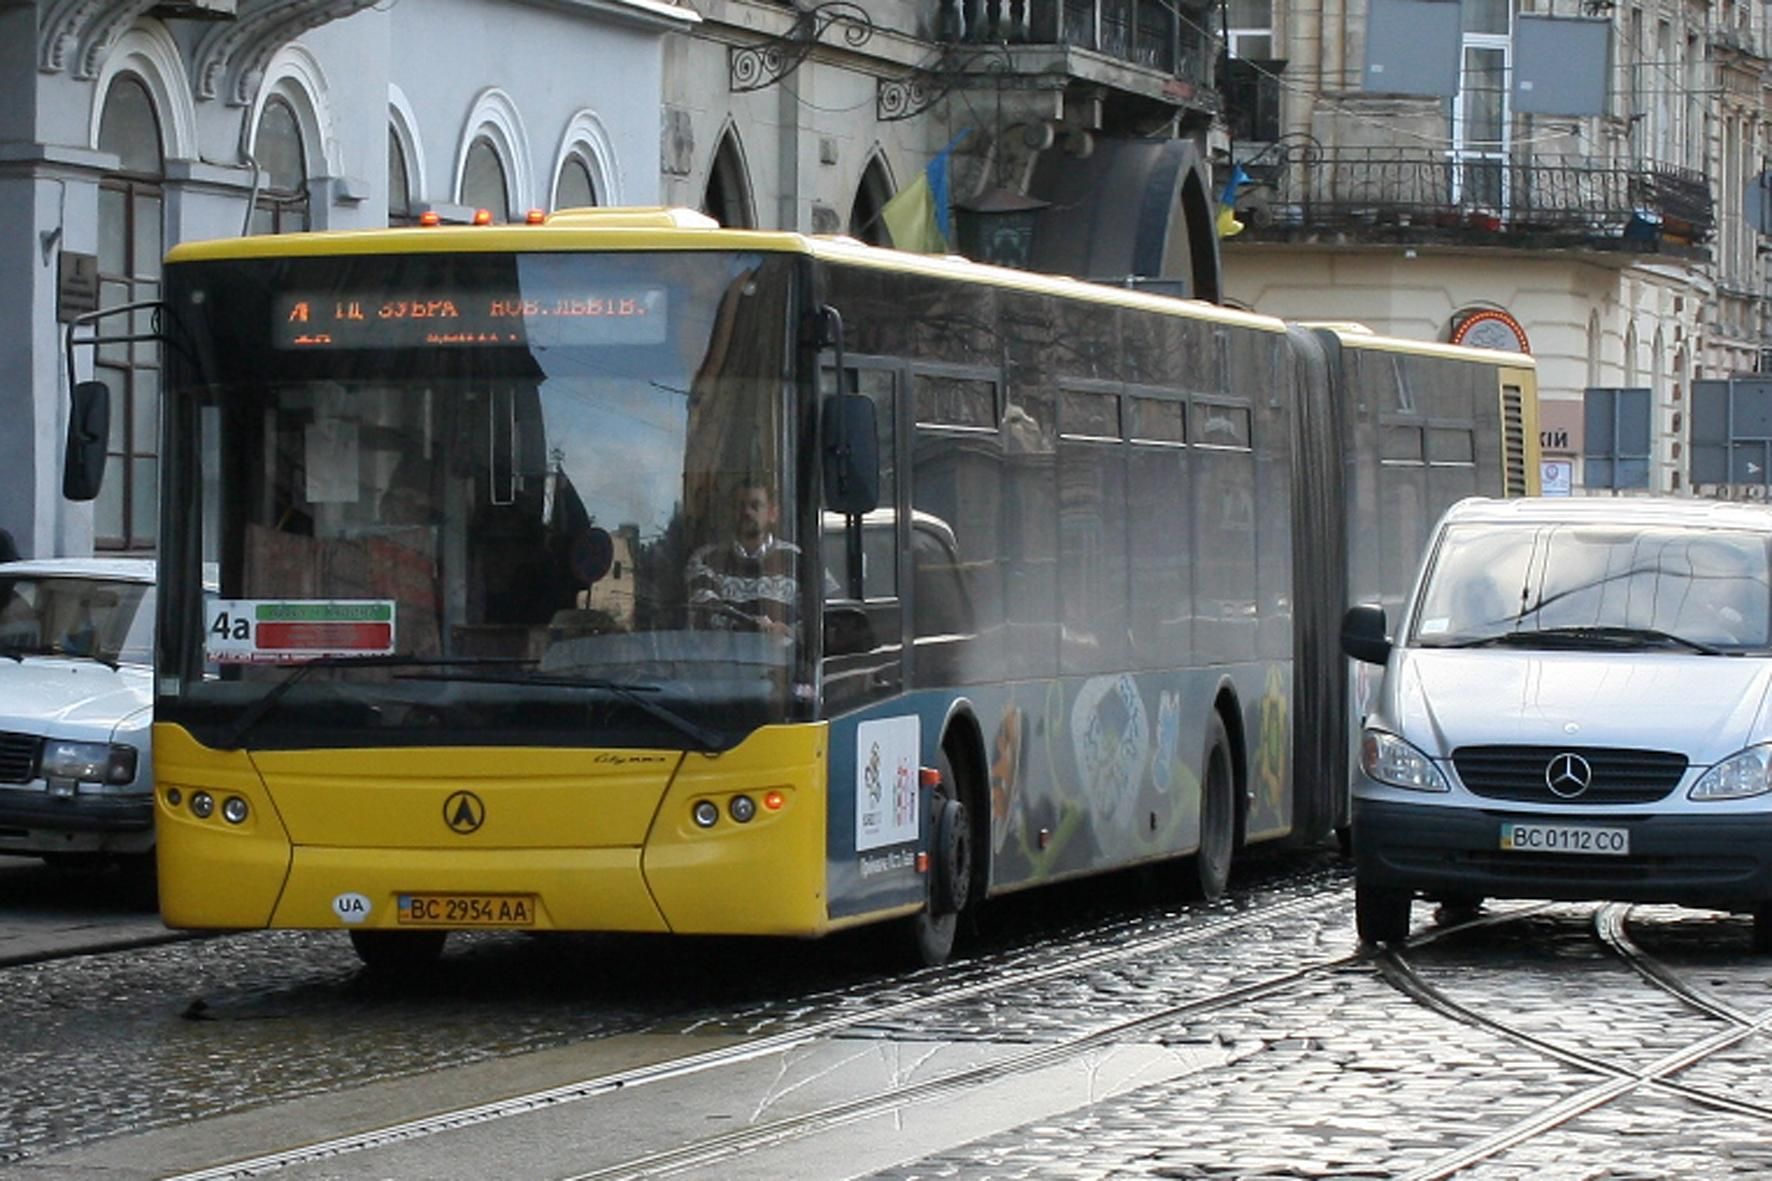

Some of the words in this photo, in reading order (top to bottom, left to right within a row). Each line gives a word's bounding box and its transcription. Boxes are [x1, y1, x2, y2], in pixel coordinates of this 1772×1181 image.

[211, 611, 250, 641] 4a
[1513, 827, 1543, 848] BC
[1546, 829, 1592, 850] 0112
[338, 898, 365, 914] UA
[410, 898, 441, 920] BC
[446, 899, 493, 921] 2954
[499, 900, 528, 921] AA
